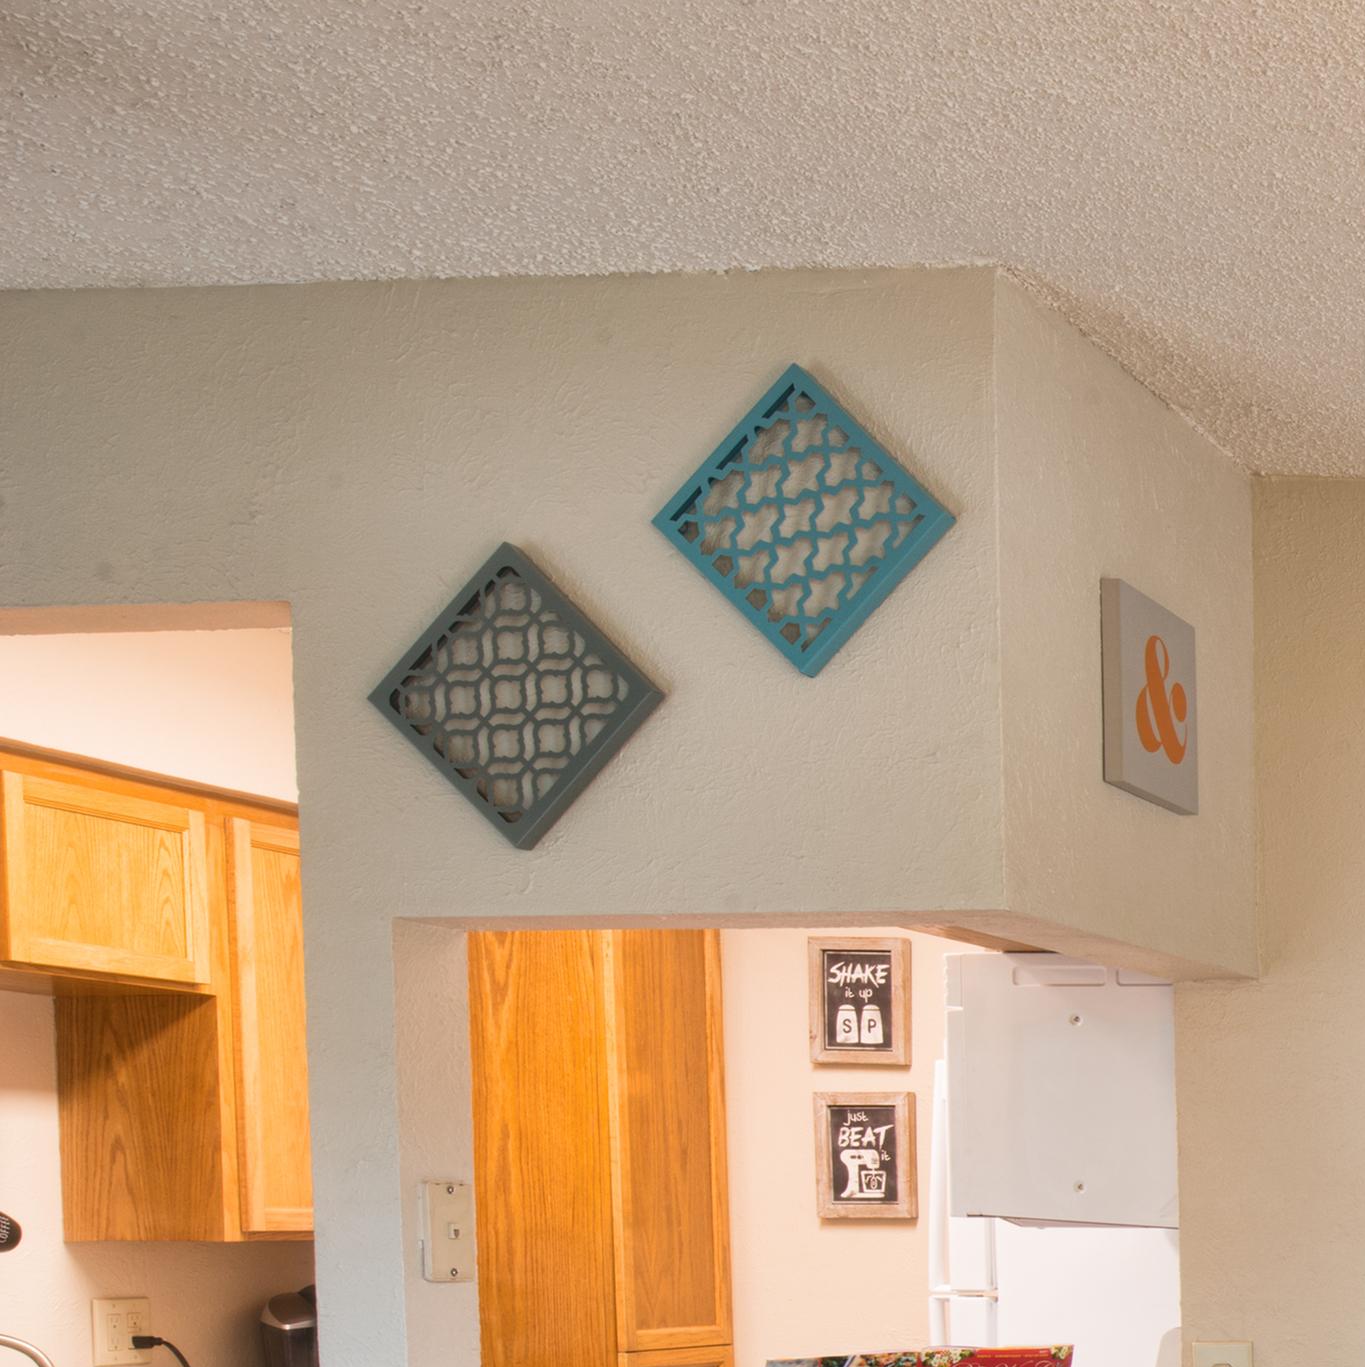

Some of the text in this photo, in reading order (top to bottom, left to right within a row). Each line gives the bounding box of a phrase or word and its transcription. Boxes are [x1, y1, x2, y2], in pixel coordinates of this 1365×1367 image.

[1136, 635, 1187, 765] &
[828, 961, 890, 988] SHAKE
[845, 986, 873, 1003] it up
[842, 1018, 877, 1034] S P
[843, 1109, 869, 1126] just
[838, 1124, 894, 1150] BEAT
[881, 1150, 892, 1161] it
